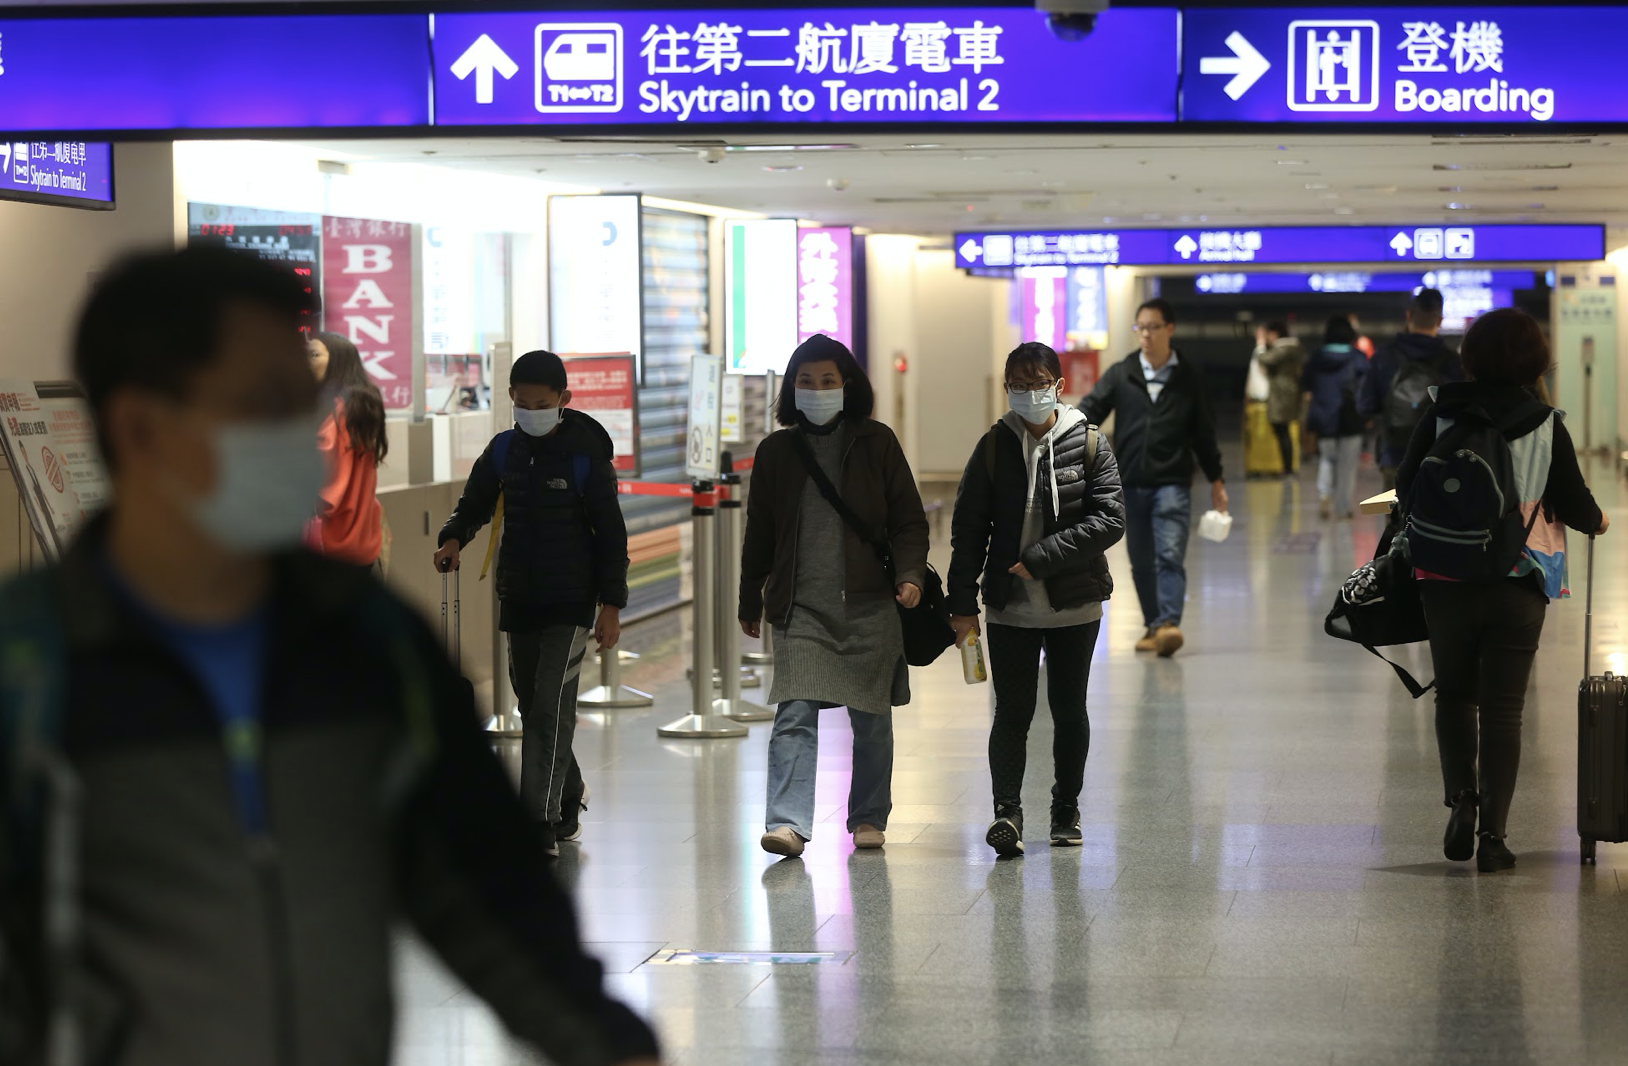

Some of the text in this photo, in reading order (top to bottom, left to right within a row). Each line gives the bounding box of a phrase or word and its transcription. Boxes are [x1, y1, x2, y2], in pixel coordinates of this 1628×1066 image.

[640, 20, 1004, 75] 往第二航廈電車
[1397, 21, 1504, 74] 登機
[548, 84, 614, 102] T1 T2
[639, 77, 1000, 122] Skytrain to Terminal 2
[1395, 78, 1554, 121] Boarding
[31, 164, 87, 192] Skytrain to Terminal 2
[341, 244, 398, 380] BANK
